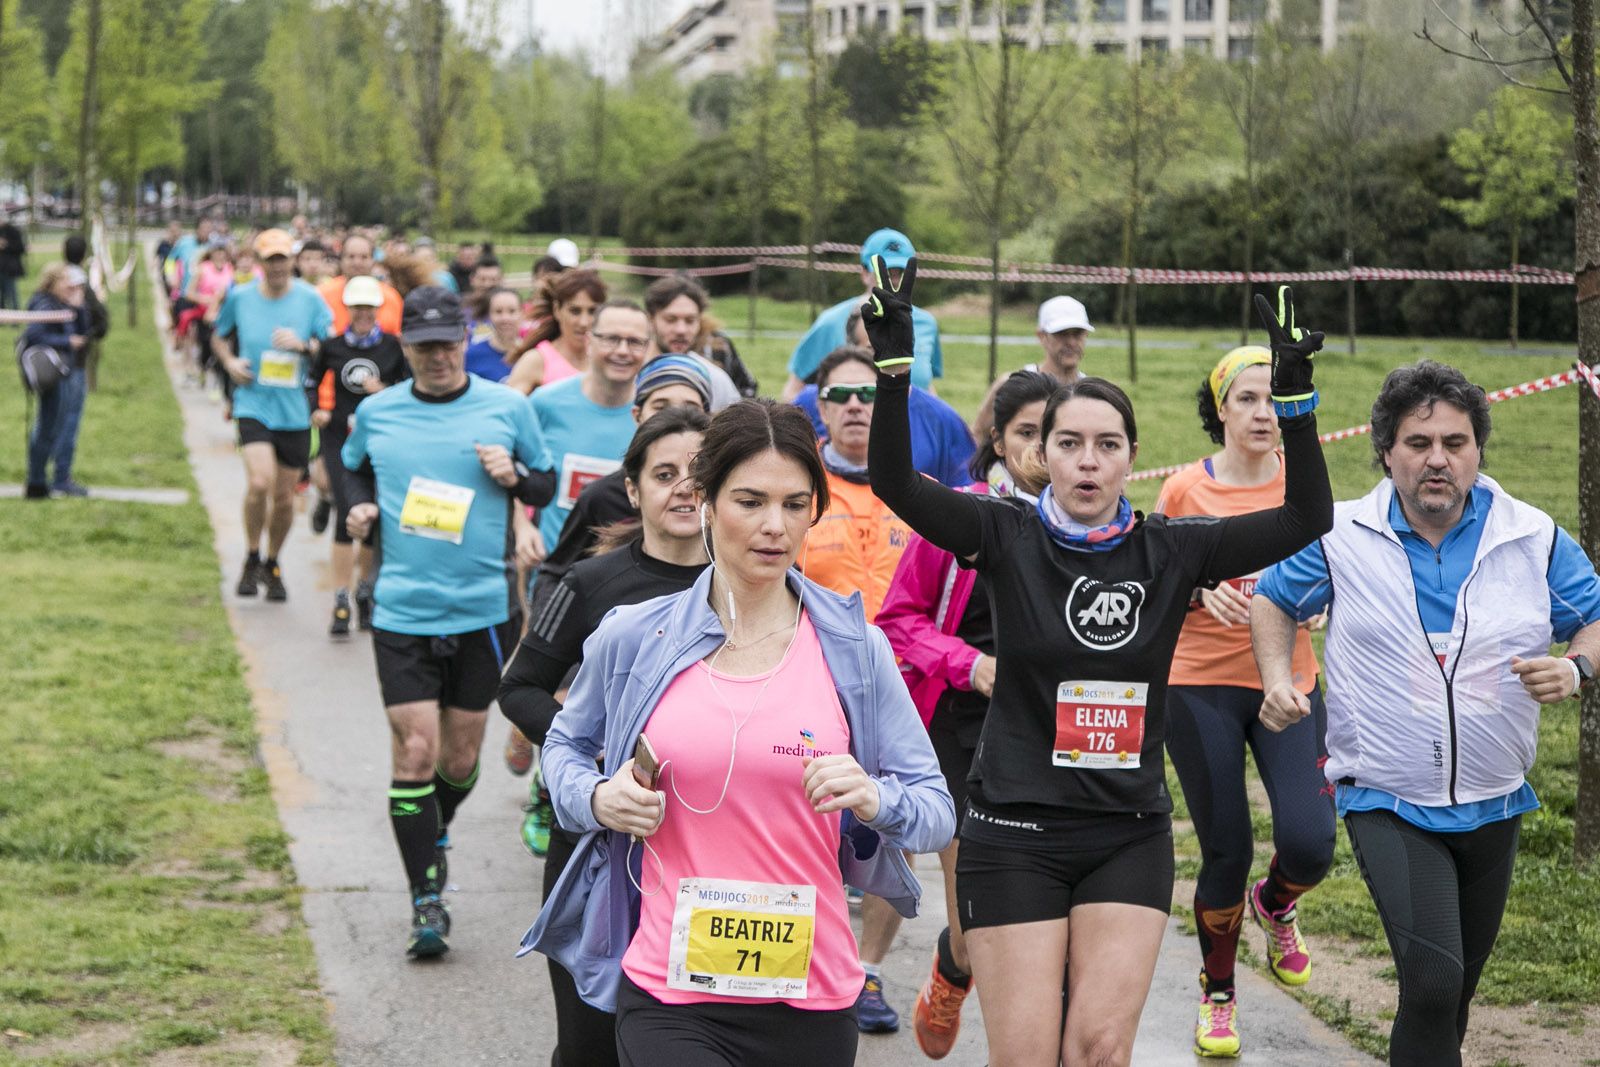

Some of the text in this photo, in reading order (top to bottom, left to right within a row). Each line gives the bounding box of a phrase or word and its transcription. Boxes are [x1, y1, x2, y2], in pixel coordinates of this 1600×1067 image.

[1077, 591, 1132, 626] AR
[1086, 629, 1126, 642] BARCELONA
[1075, 707, 1128, 729] ELENA
[1086, 731, 1116, 751] 176
[1433, 740, 1443, 767] LIGHT
[710, 916, 795, 943] BEATRIZ
[736, 949, 761, 972] 71
